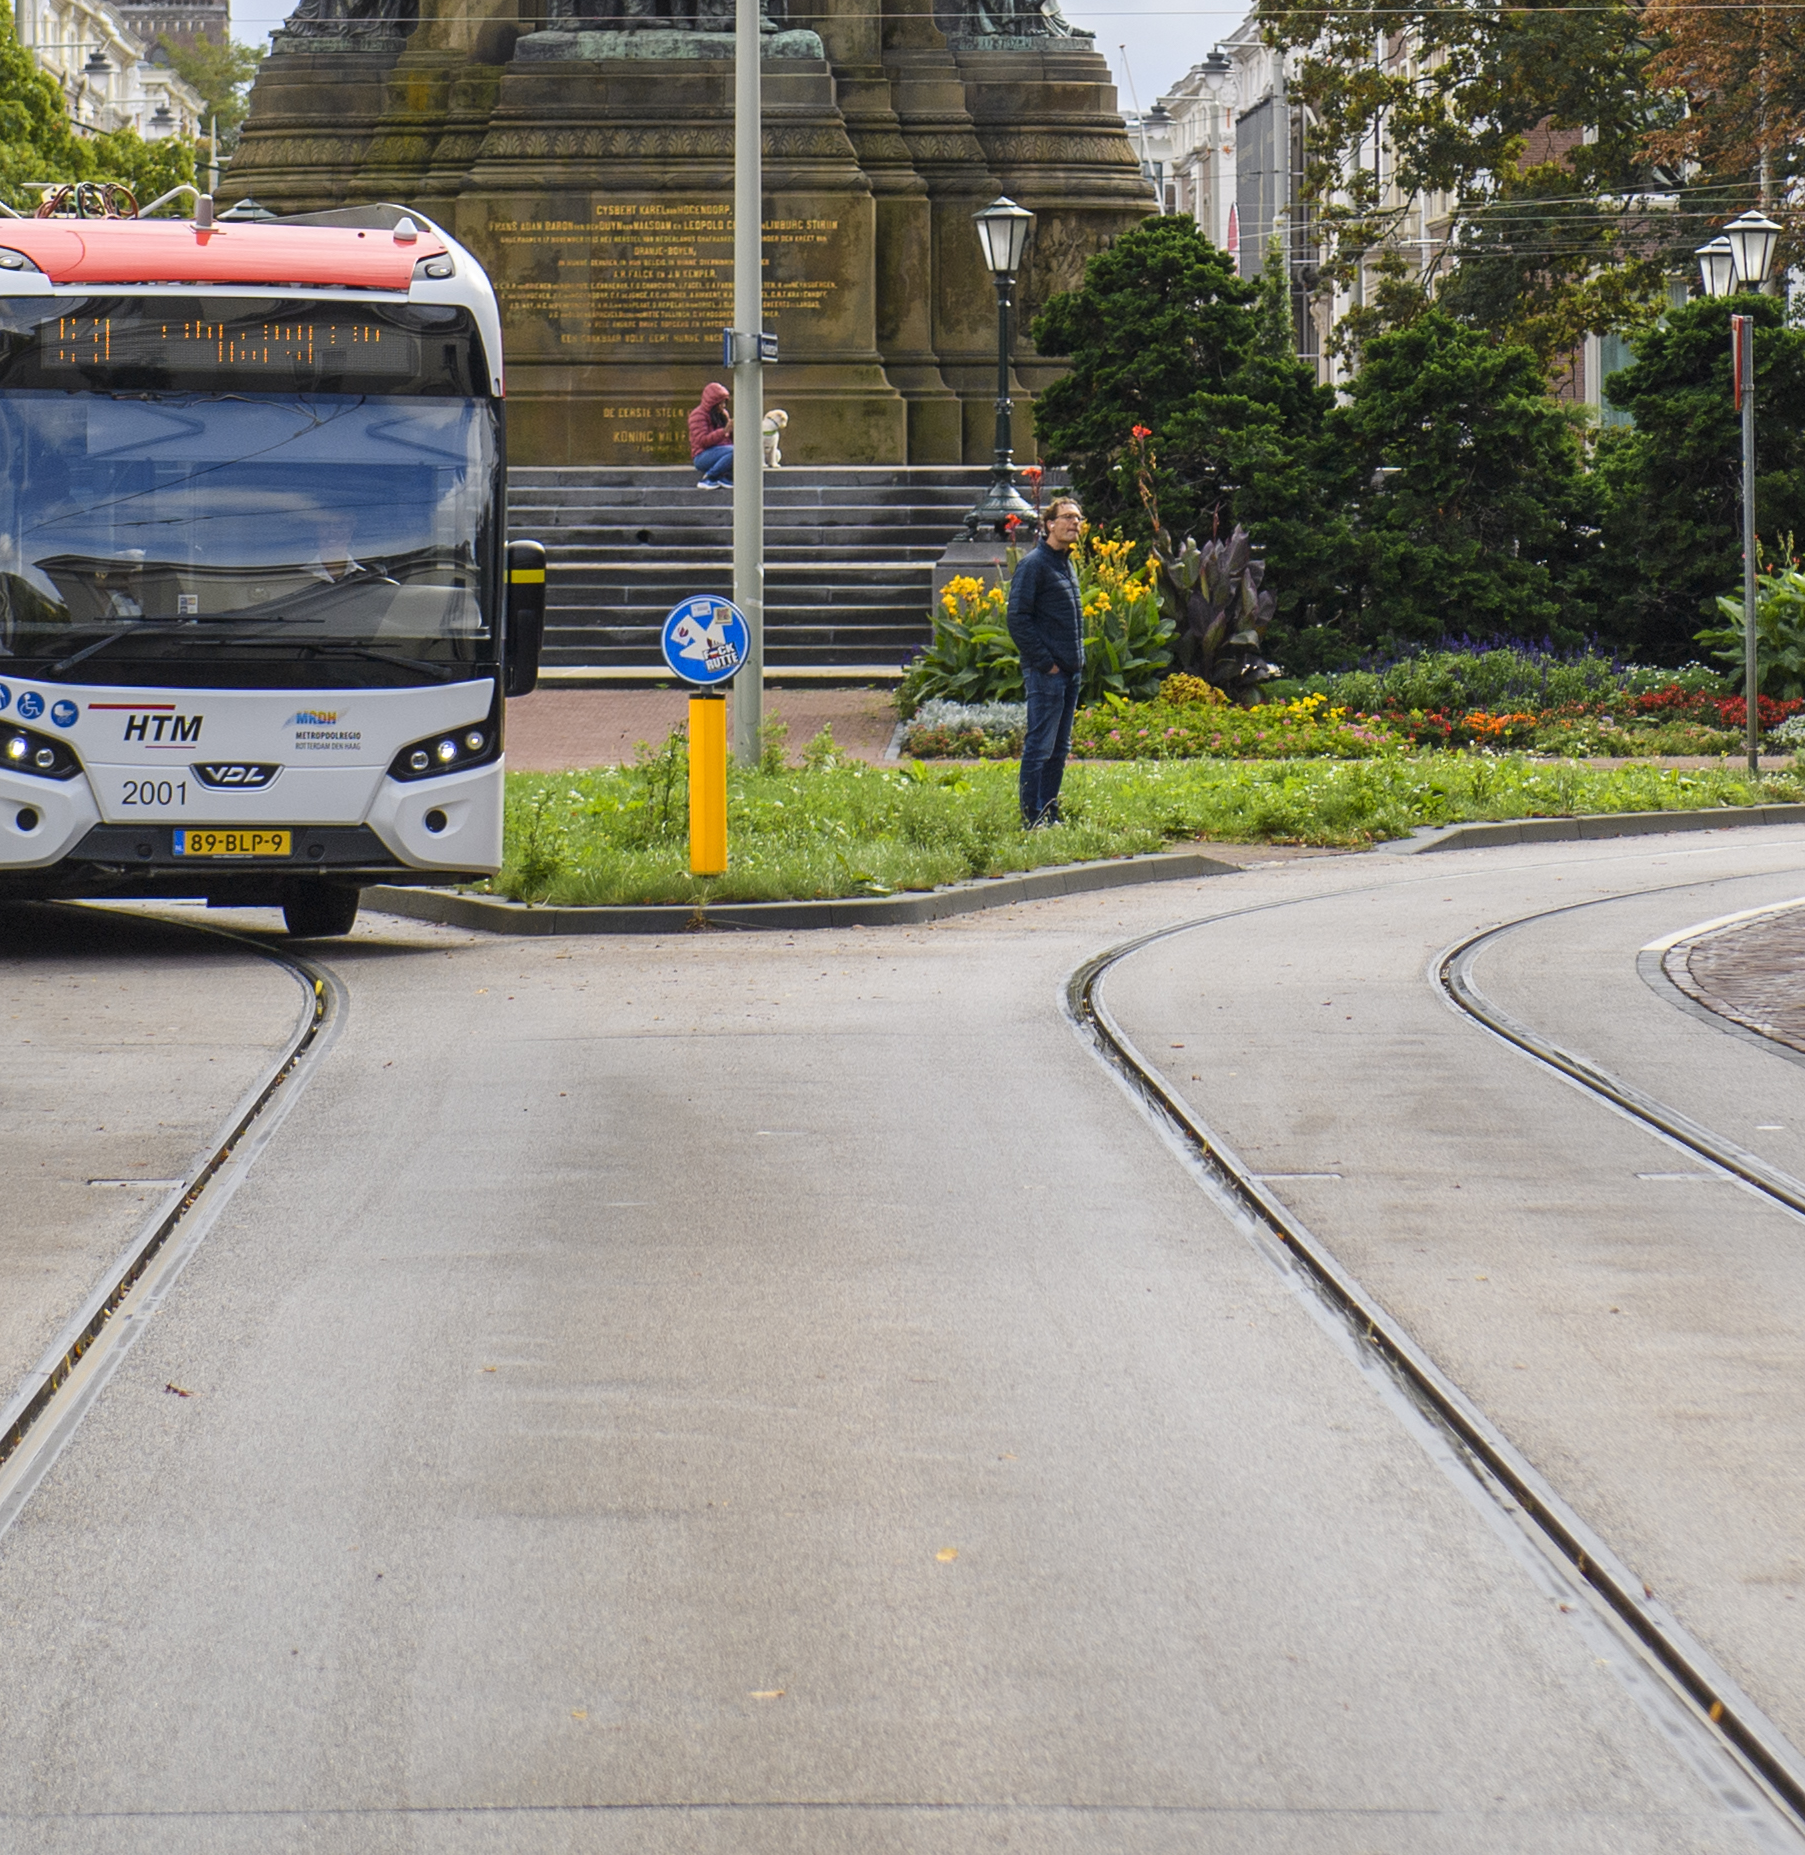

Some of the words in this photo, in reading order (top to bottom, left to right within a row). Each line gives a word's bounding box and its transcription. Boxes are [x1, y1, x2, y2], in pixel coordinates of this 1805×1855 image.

[705, 652, 739, 671] RUTTE
[296, 710, 337, 725] MRDH
[123, 714, 204, 742] HTM
[295, 731, 362, 740] METROPOOLREGIO
[295, 742, 331, 750] ROTTERDAM
[331, 742, 344, 750] DEN
[344, 742, 361, 750] HAAG
[205, 766, 266, 783] VDL
[121, 780, 187, 806] 2001
[190, 833, 283, 852] 89-BLP-9
